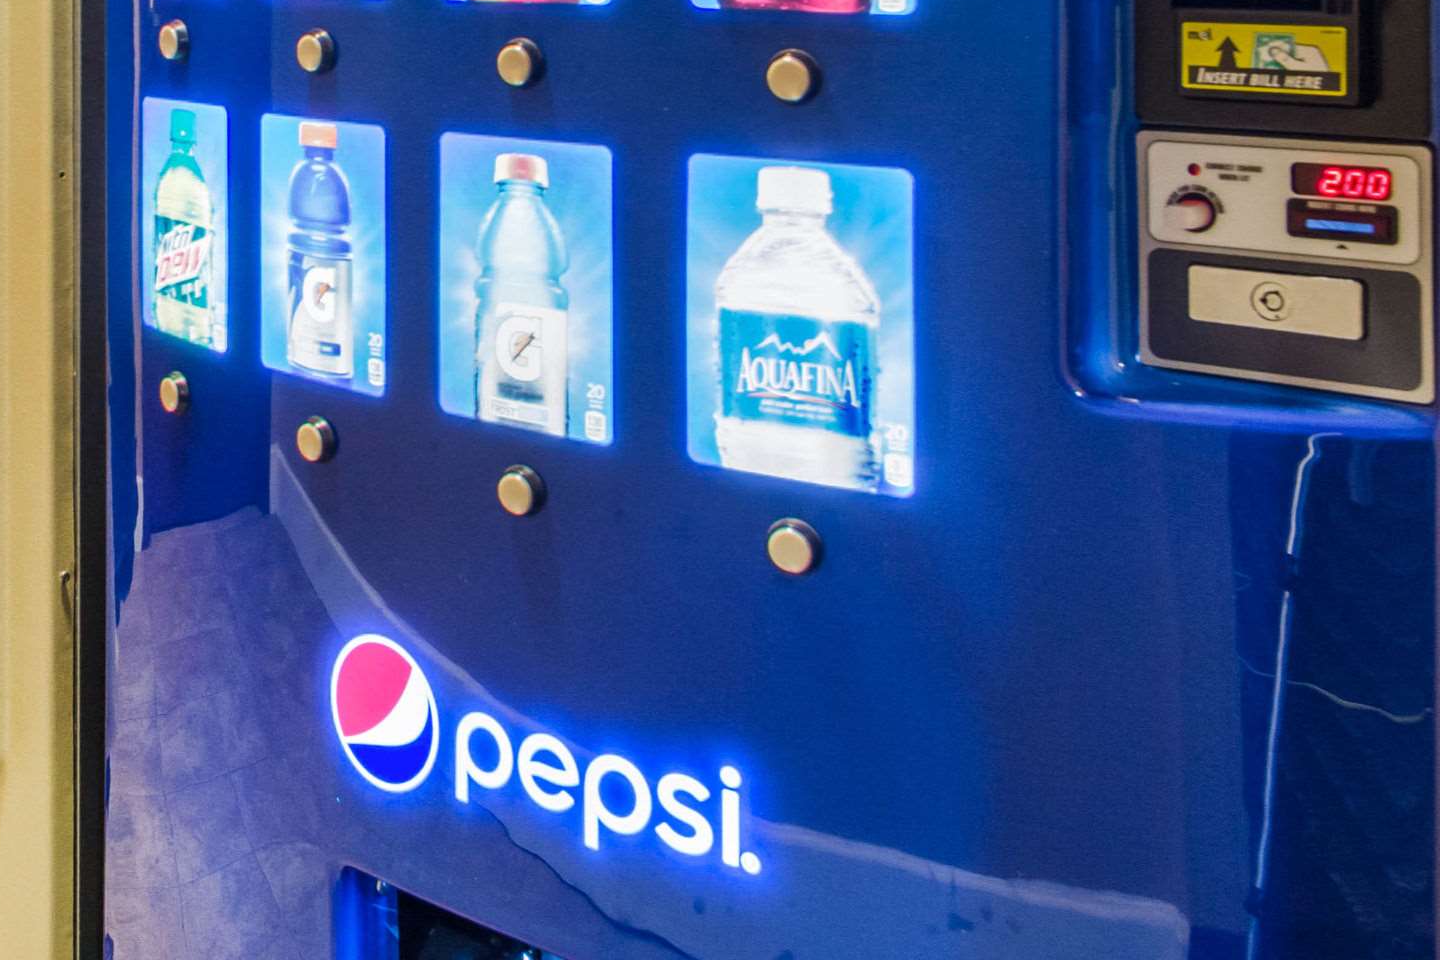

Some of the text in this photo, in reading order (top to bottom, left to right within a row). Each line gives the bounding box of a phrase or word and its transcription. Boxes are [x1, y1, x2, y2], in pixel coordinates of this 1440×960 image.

[1197, 67, 1323, 90] INSERT BILL HERE
[736, 346, 860, 409] AQUAFINA
